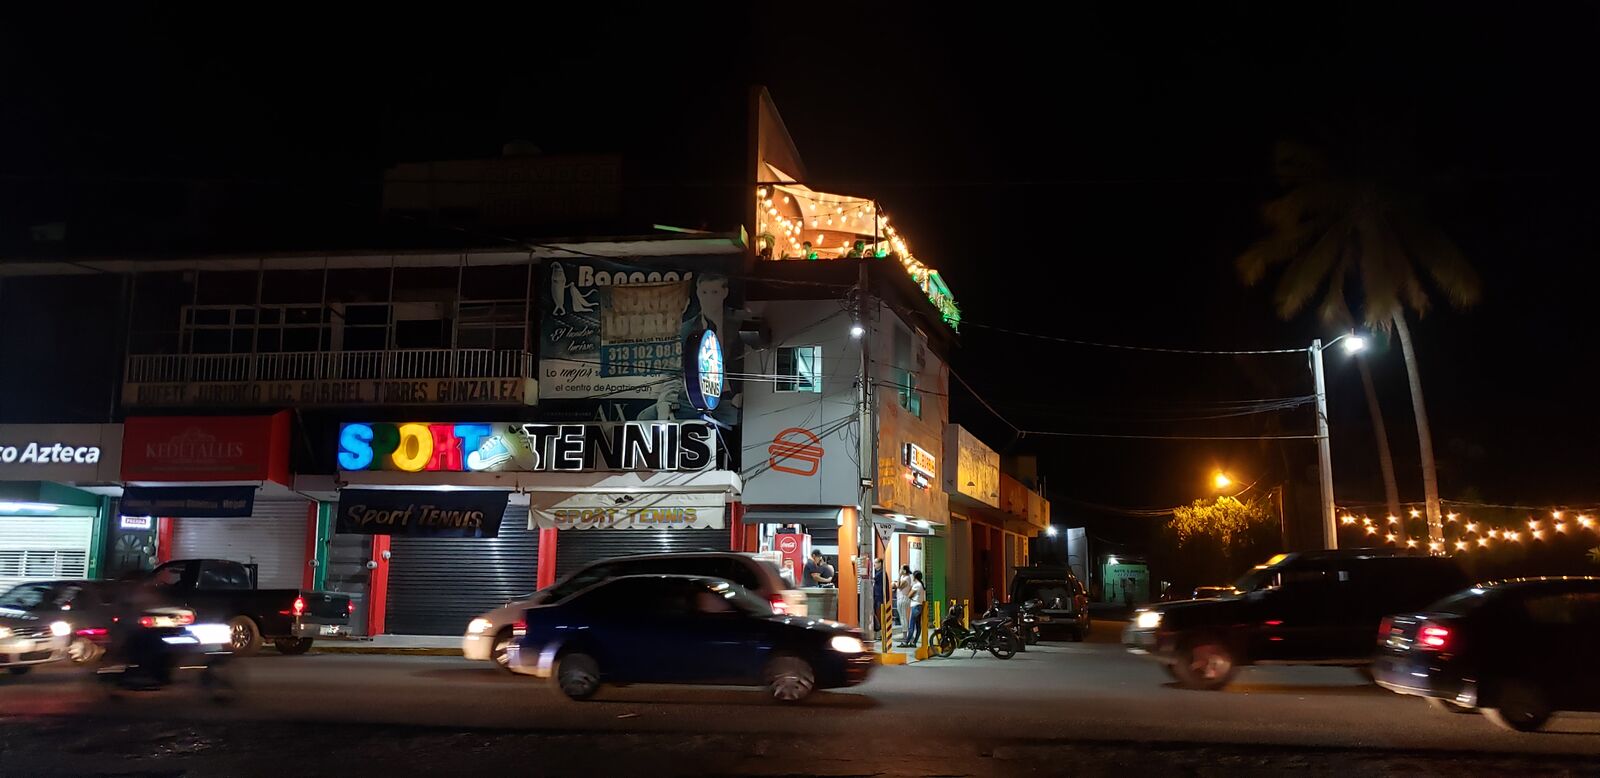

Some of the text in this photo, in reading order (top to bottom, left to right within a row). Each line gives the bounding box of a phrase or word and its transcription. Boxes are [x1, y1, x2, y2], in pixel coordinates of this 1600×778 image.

[608, 347, 630, 360] 313
[632, 345, 653, 359] 102
[546, 369, 557, 377] Lo
[560, 364, 592, 383] mejor
[555, 384, 564, 392] el
[565, 384, 591, 392] centro
[593, 383, 604, 392] de
[0, 442, 100, 463] o Azteca
[338, 422, 712, 472] SPORT TENNIS
[348, 503, 415, 526] Sport
[554, 507, 698, 524] SPORT TENNIS
